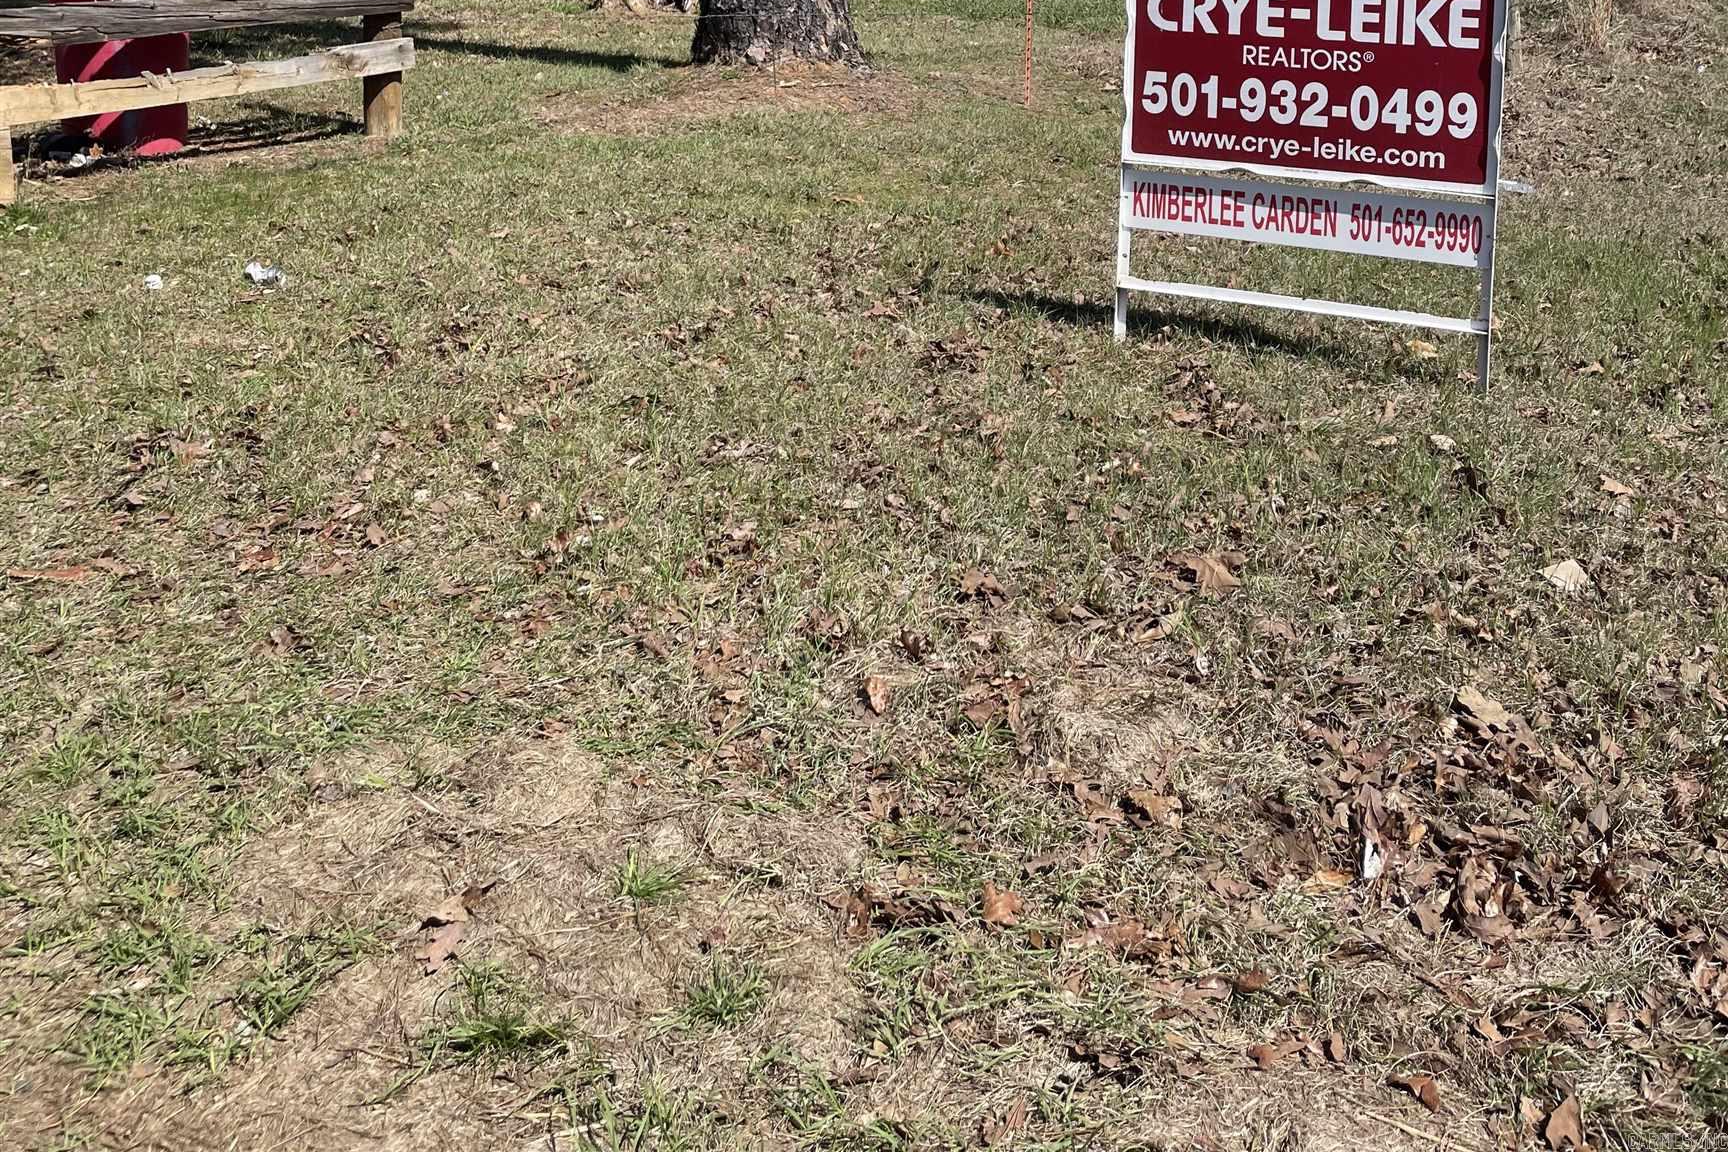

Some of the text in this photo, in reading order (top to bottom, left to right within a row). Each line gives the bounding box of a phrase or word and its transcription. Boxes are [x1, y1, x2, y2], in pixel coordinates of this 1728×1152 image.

[1141, 70, 1478, 139] 501-932-0499
[1167, 129, 1446, 169] www.crye-leike.com
[1132, 181, 1483, 254] KIMBERLEE CARDEN 501-652-9990
